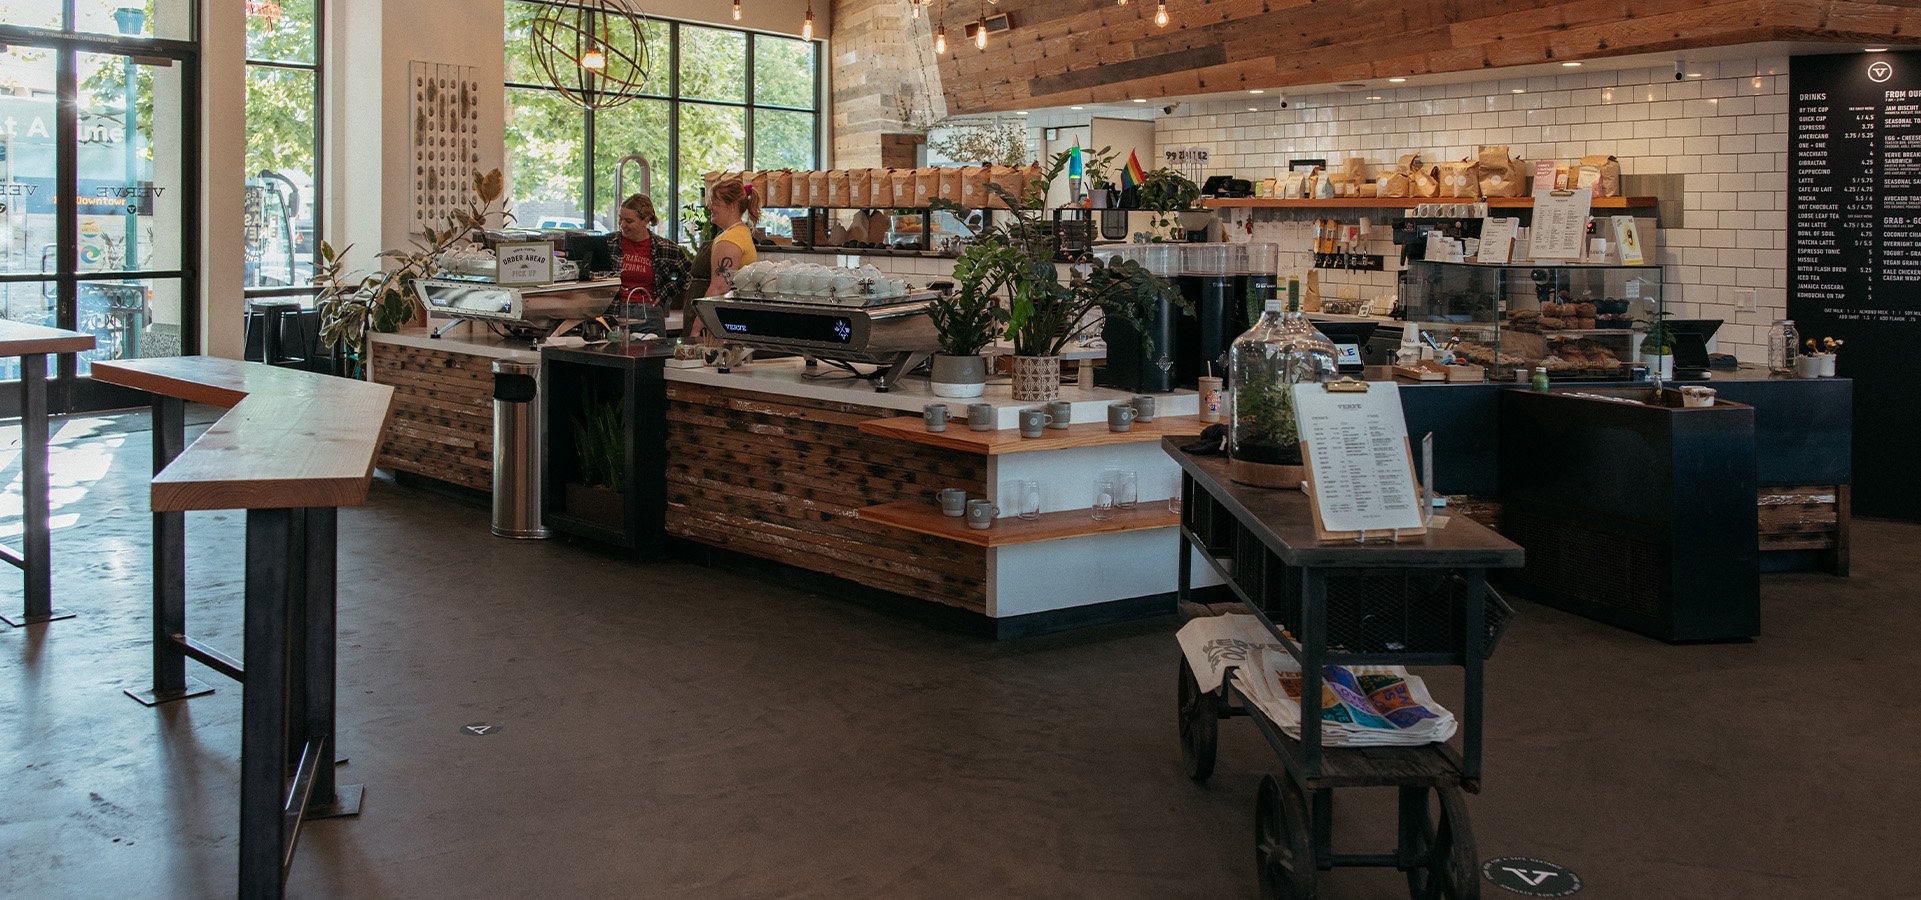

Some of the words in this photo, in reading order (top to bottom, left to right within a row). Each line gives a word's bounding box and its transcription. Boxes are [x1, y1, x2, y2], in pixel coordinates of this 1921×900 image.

[1166, 151, 1176, 160] 99
[503, 255, 523, 265] ORDER
[525, 254, 546, 264] AHEAD
